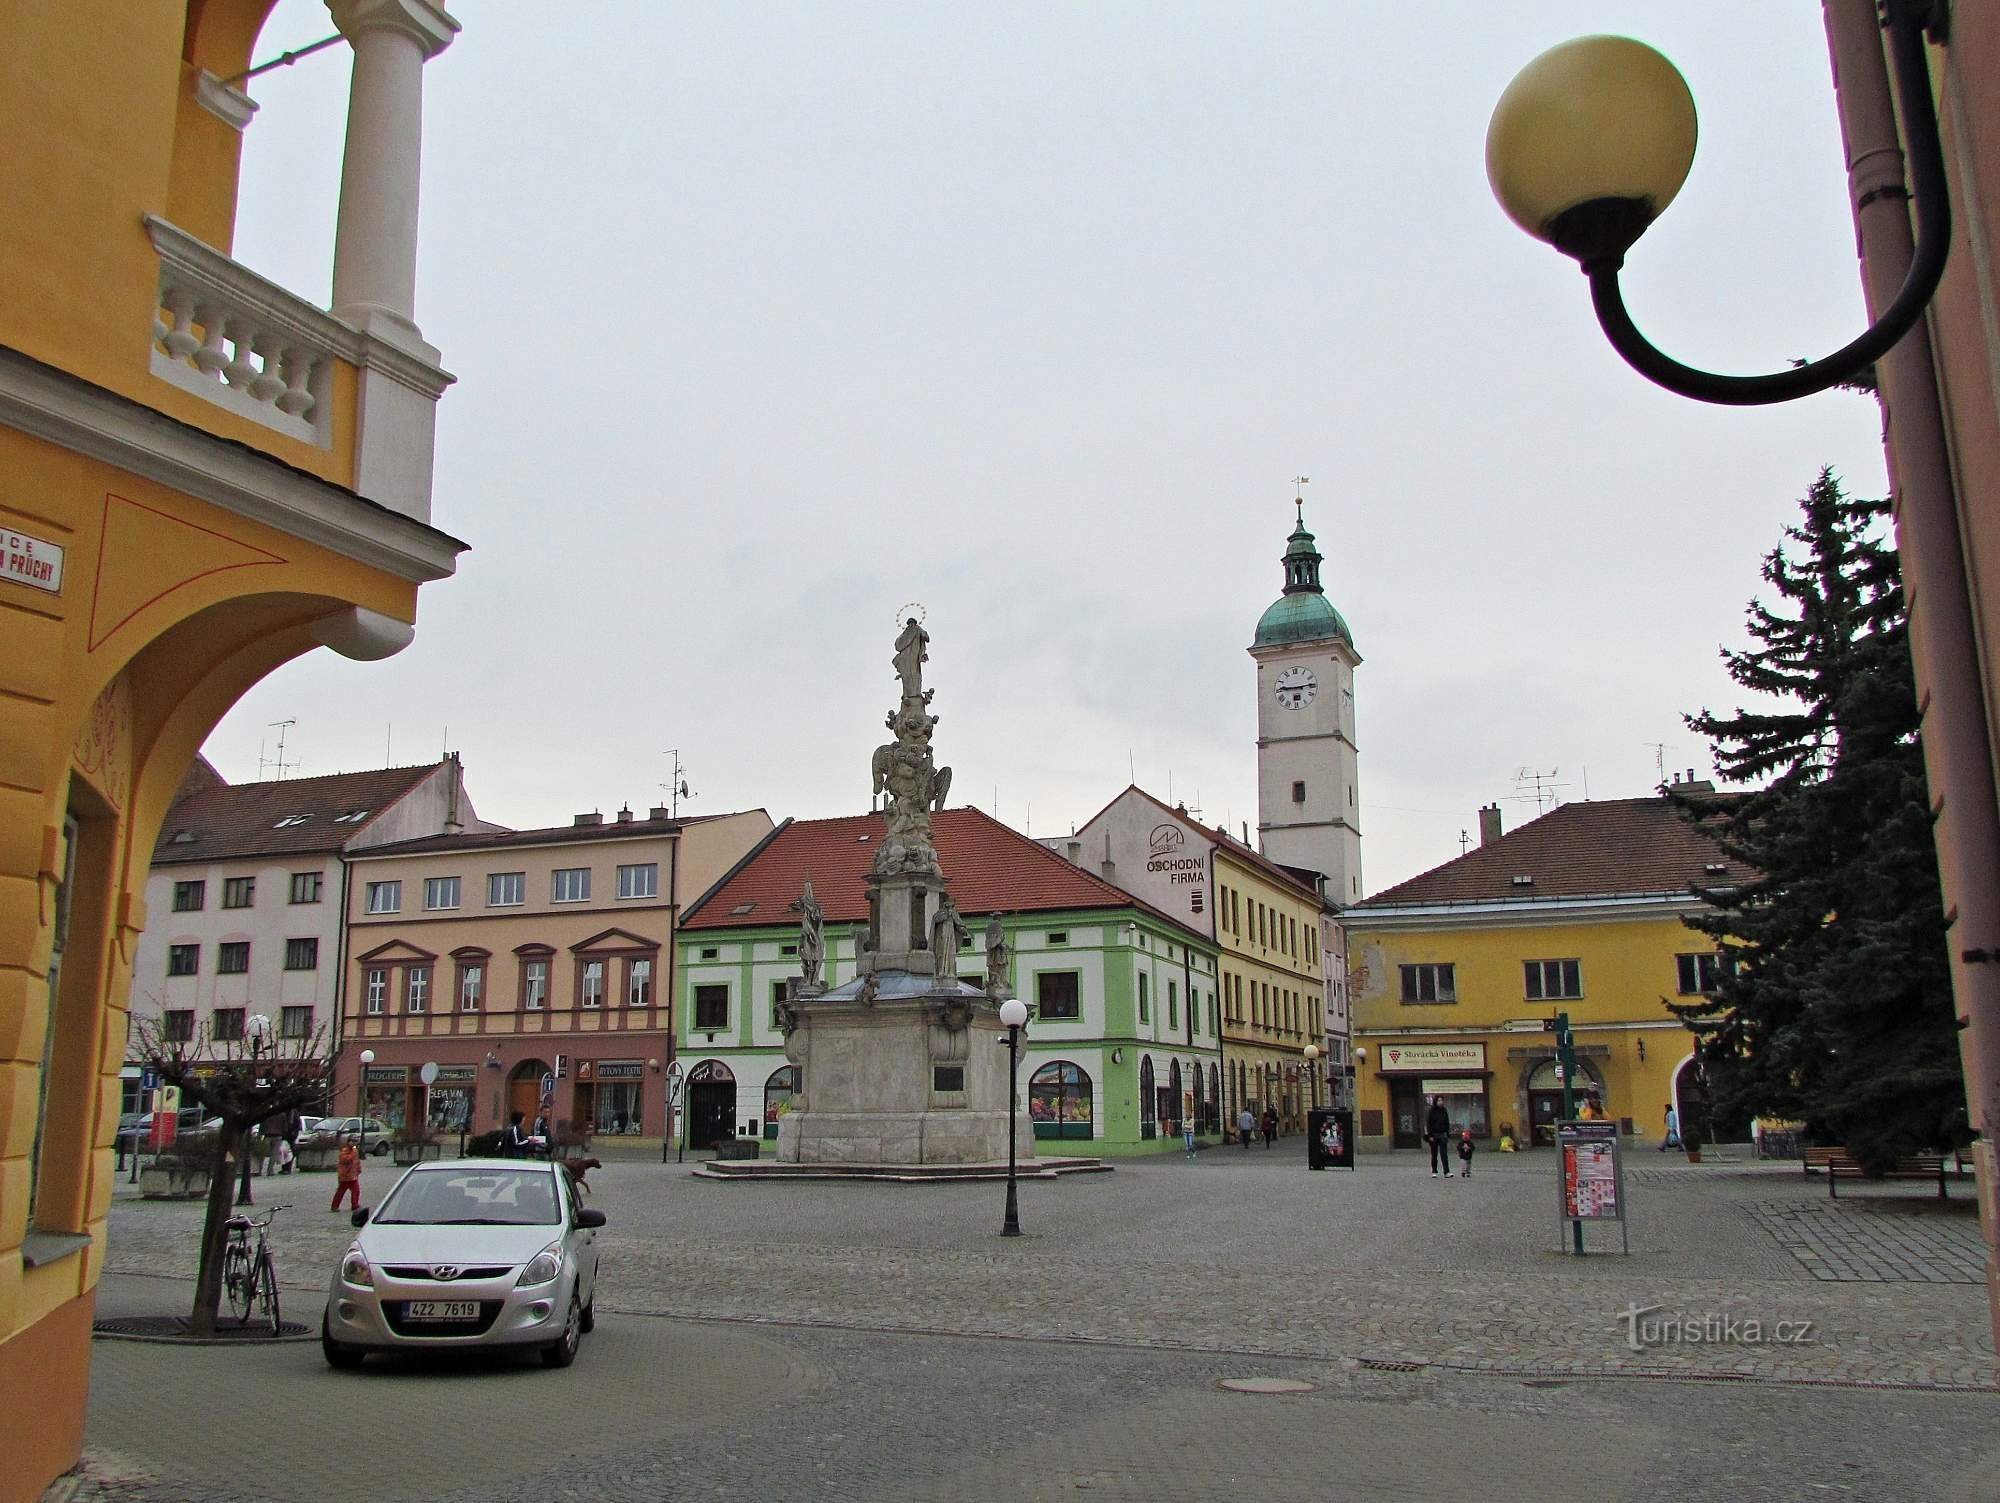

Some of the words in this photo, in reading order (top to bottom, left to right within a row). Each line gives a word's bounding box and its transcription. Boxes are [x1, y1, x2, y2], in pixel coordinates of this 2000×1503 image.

[1171, 872, 1204, 884] FIRMA
[412, 1304, 434, 1316] 4Z2
[444, 1303, 474, 1316] 7619
